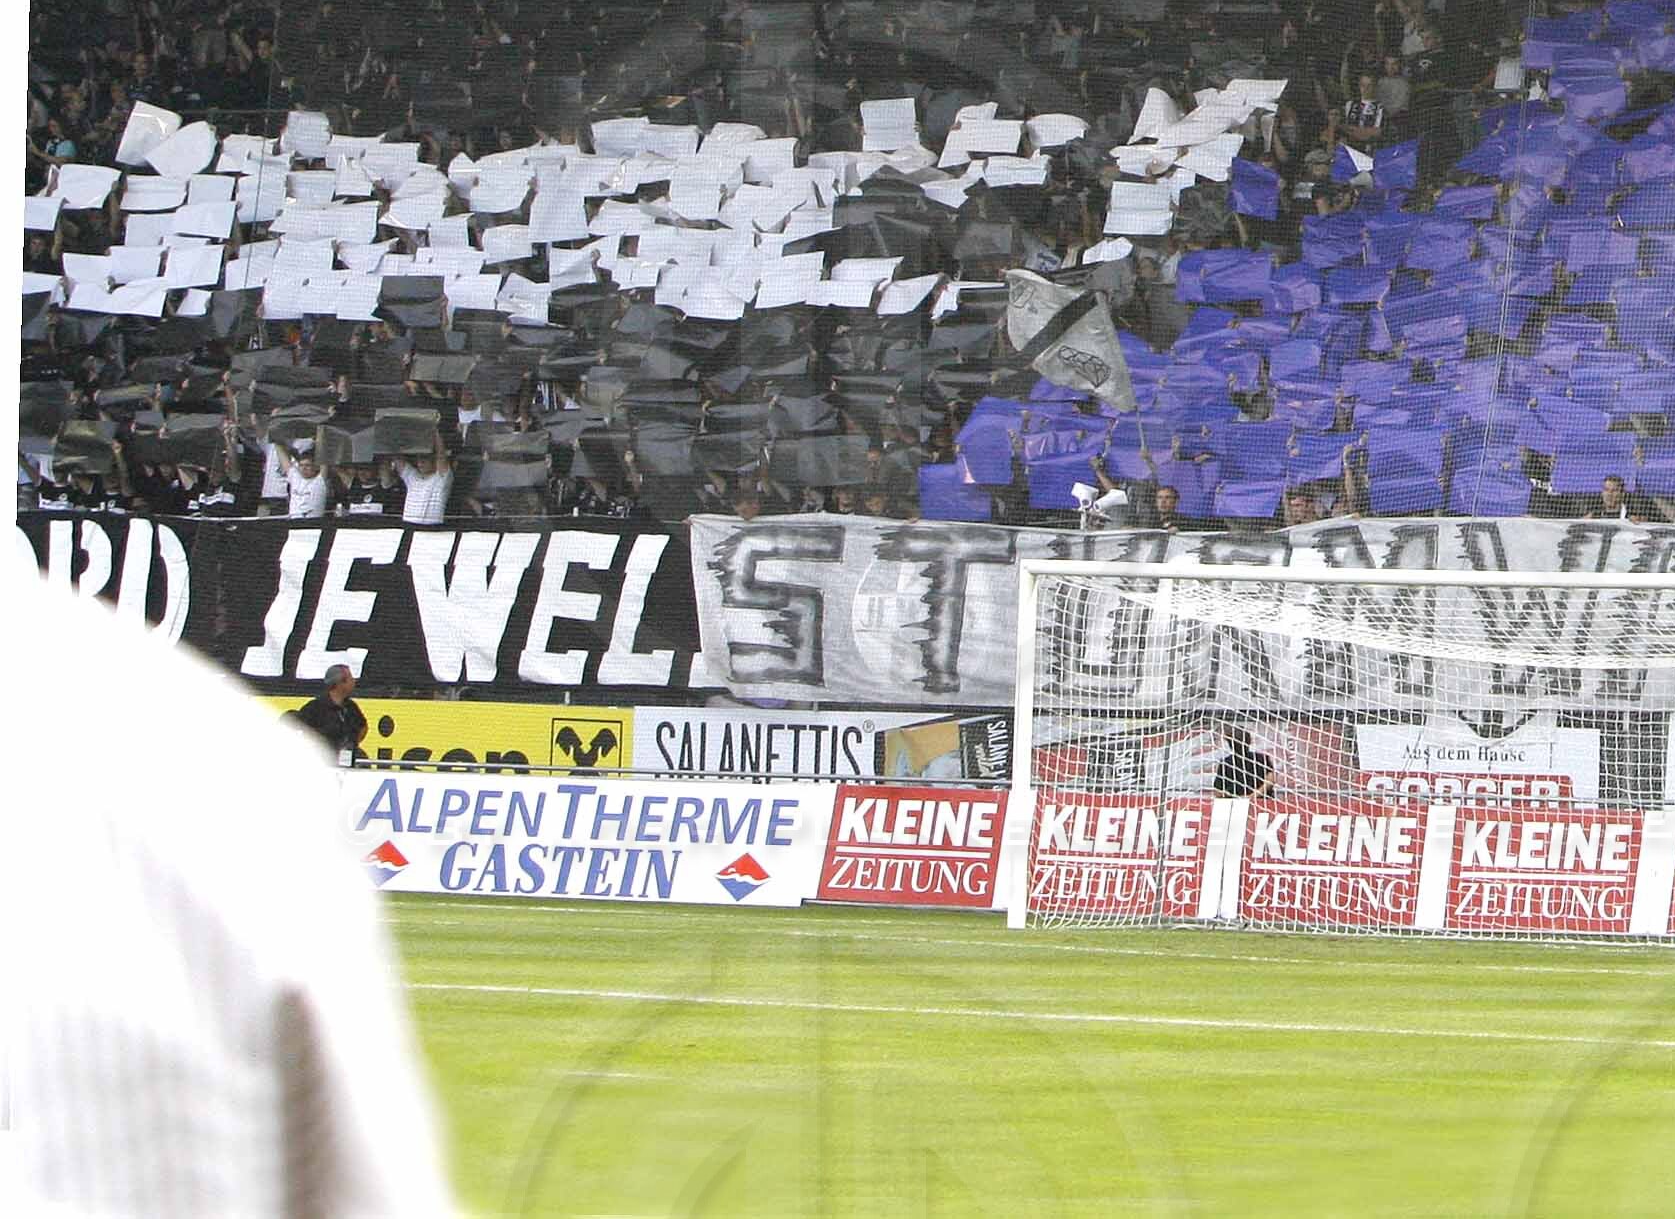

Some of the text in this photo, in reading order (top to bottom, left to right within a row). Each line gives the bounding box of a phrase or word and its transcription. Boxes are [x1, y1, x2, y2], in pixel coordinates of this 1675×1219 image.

[1436, 745, 1471, 762] dem
[355, 777, 800, 847] ALPEN THERME
[838, 795, 997, 847] KLEINE
[1034, 804, 1203, 857] KLEINE
[1250, 812, 1414, 865] KLEINE
[1462, 821, 1633, 871] KLEINE
[438, 841, 683, 899] GASTEIN
[827, 858, 990, 898] ZEITUNG
[1030, 864, 1198, 907] ZEITUNG
[1246, 871, 1410, 915] ZEITUNG
[1454, 881, 1625, 920] ZEITUNG
